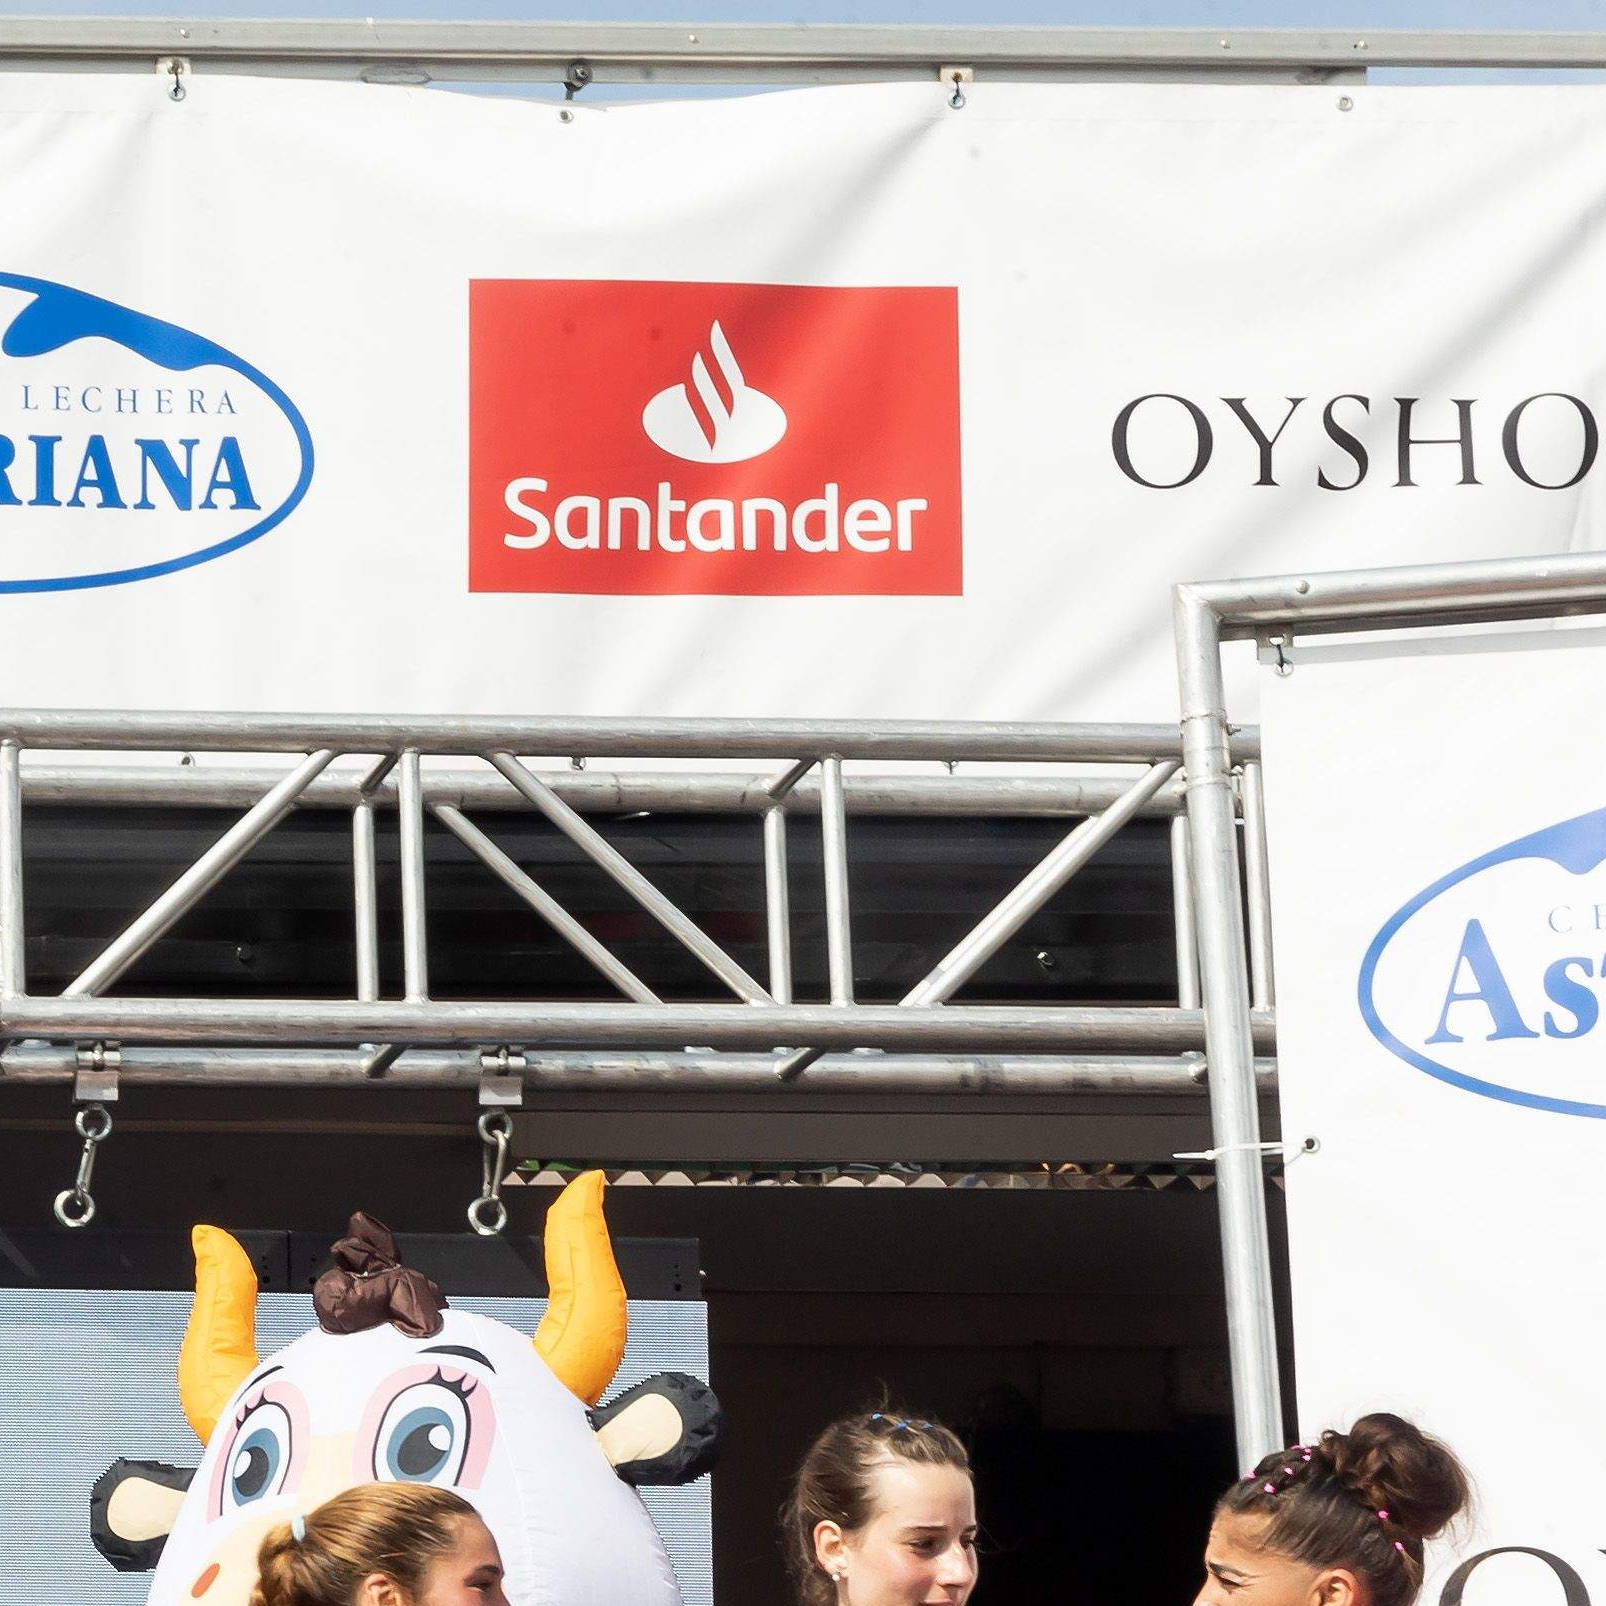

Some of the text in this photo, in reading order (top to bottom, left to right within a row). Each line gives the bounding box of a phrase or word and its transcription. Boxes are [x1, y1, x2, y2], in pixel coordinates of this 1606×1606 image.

[23, 386, 238, 415] LECHERA
[1111, 392, 1600, 492] OYSHO
[503, 477, 928, 554] Santander
